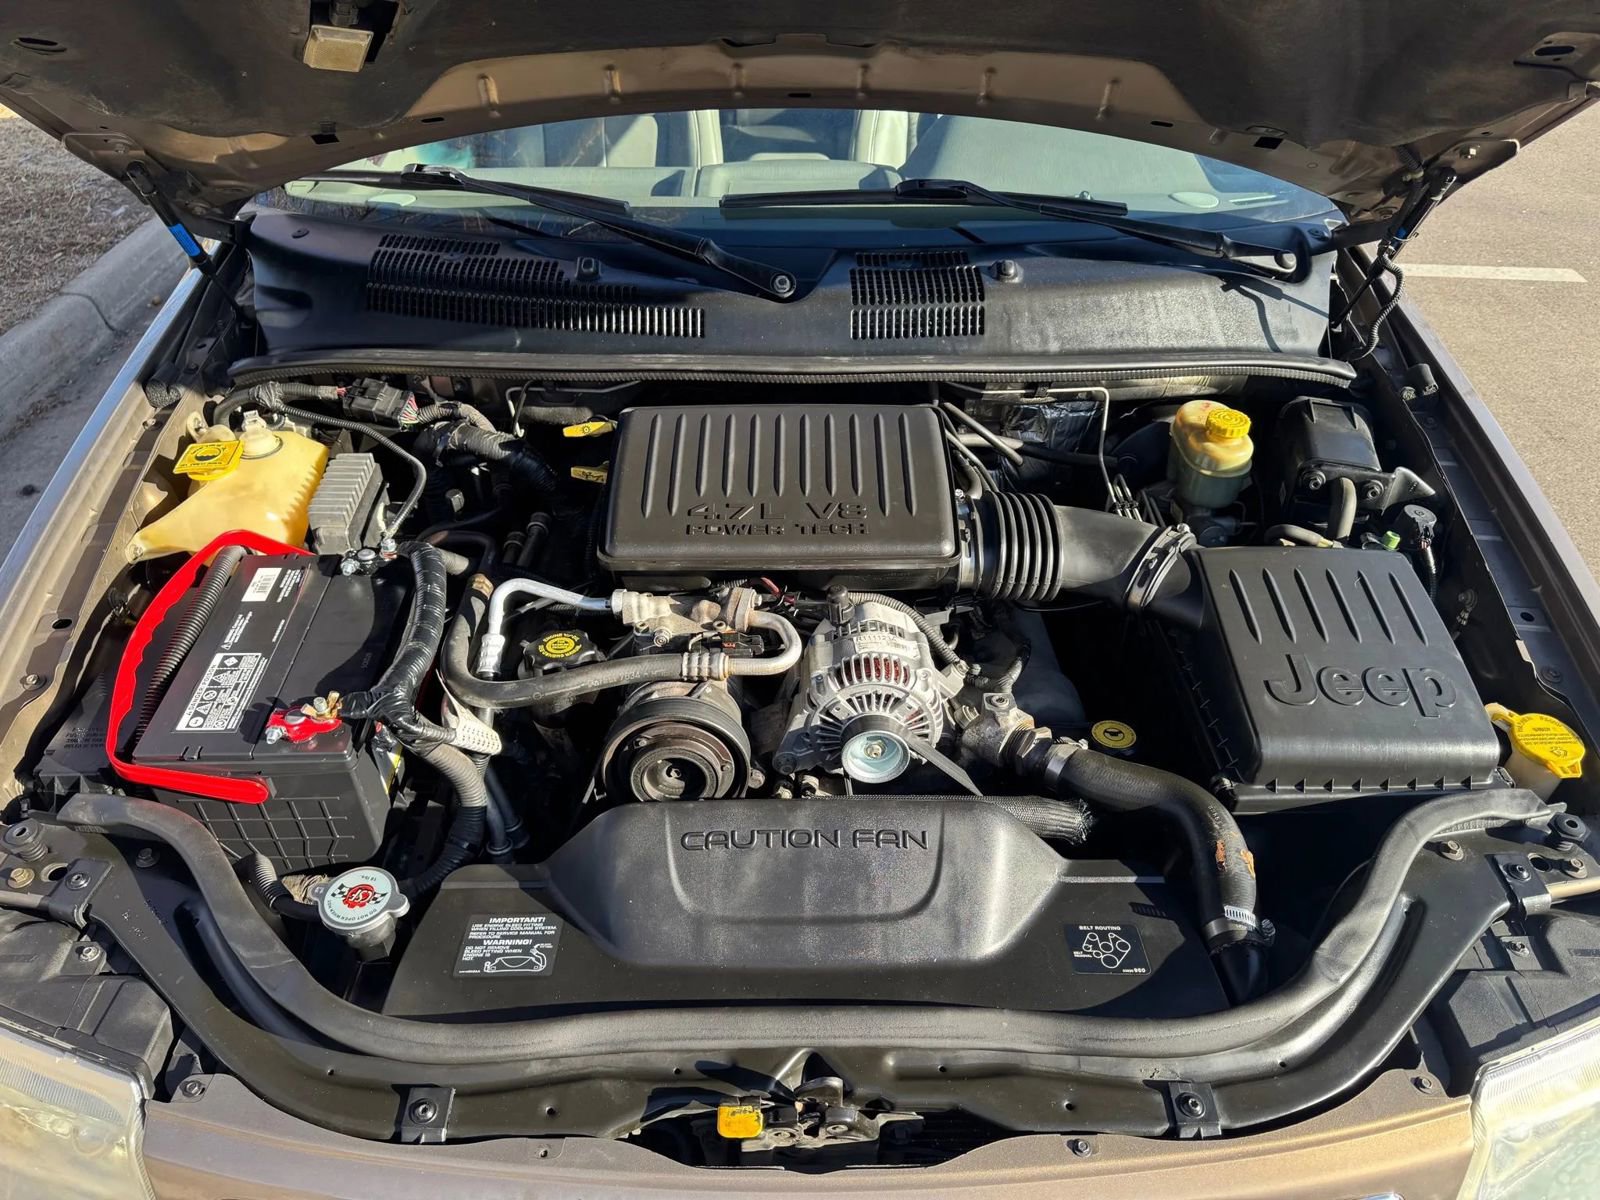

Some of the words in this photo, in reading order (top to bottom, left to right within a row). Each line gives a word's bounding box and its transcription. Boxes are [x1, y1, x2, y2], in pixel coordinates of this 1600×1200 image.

[687, 502, 785, 520] 4.7L
[805, 502, 867, 520] V8
[686, 523, 785, 535] POWER
[795, 523, 869, 535] TECH
[1263, 654, 1456, 718] Jeep
[680, 829, 840, 850] CAUTION
[852, 829, 928, 850] FAN
